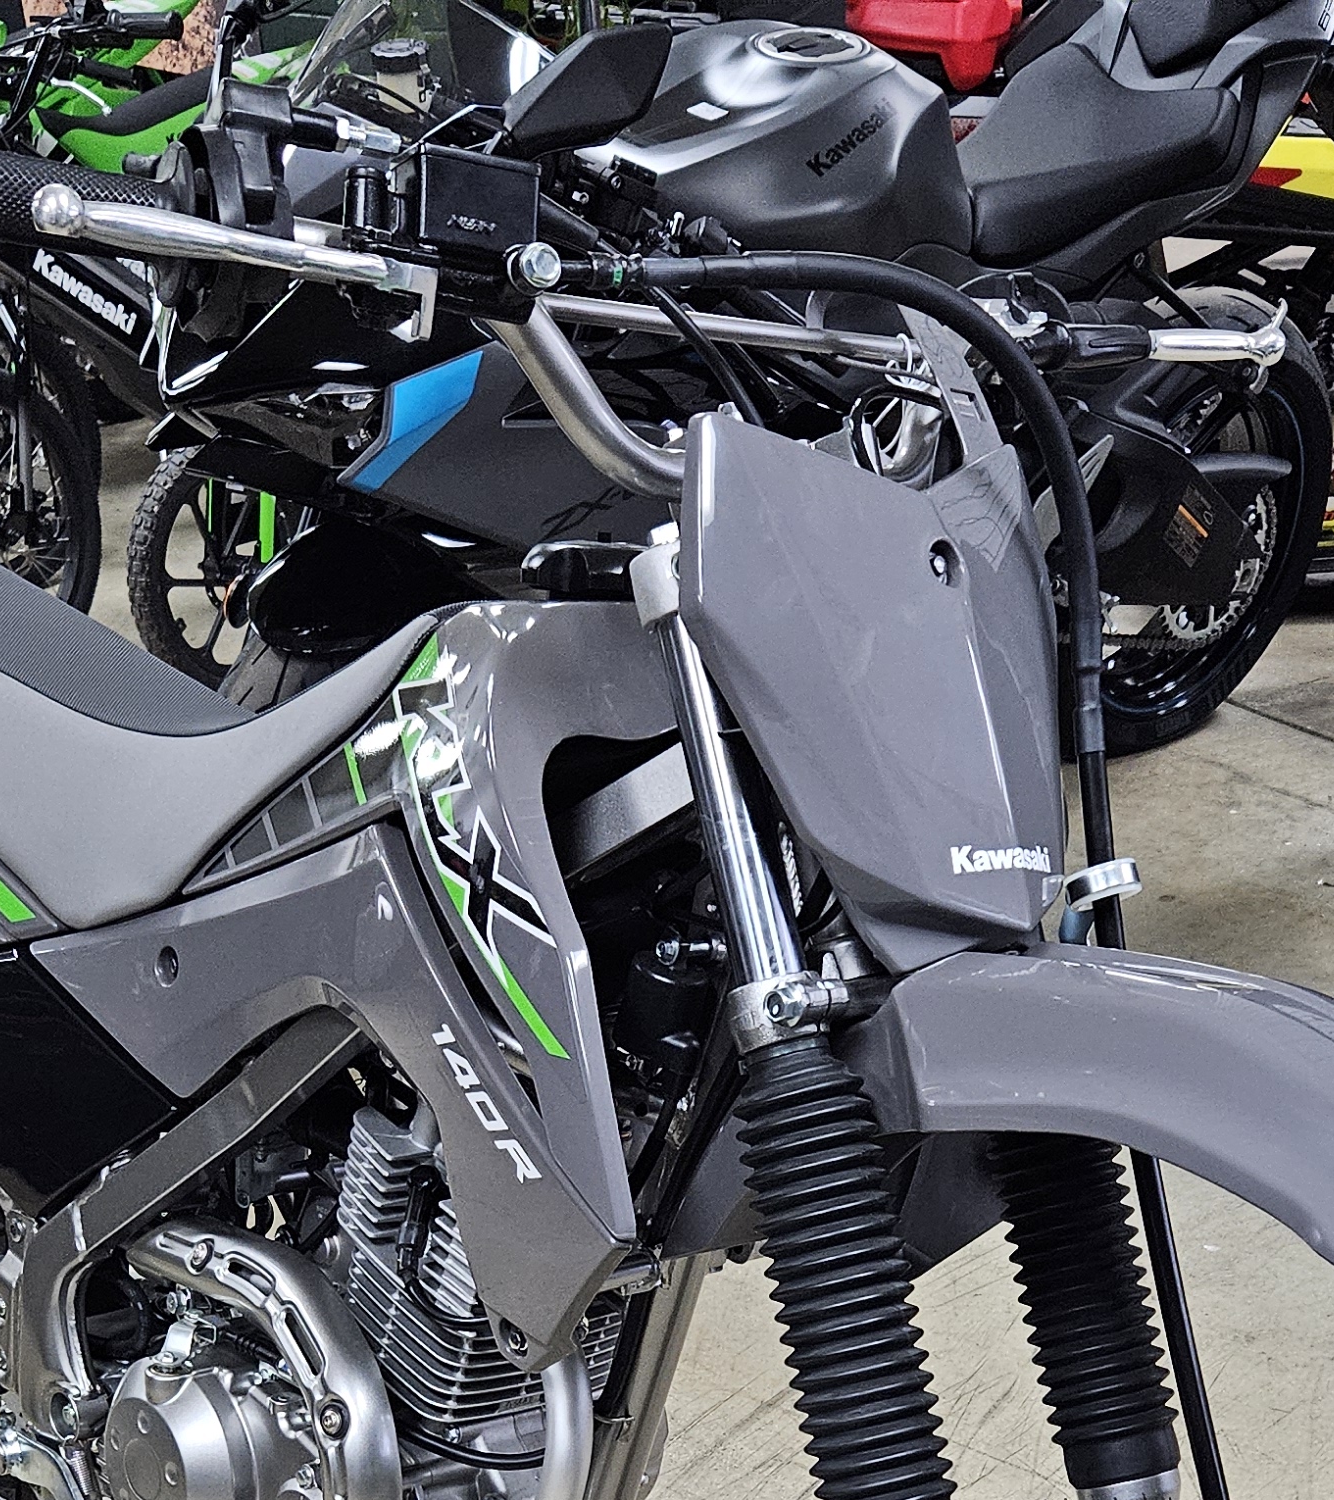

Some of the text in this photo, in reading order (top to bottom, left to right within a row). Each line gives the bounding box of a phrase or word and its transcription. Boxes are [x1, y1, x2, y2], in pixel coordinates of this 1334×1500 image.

[806, 97, 898, 177] Kawasaki
[32, 247, 138, 336] Kawasaki
[392, 672, 558, 990] KLX
[950, 844, 1052, 875] Kawasaki
[430, 1023, 544, 1184] 140R
